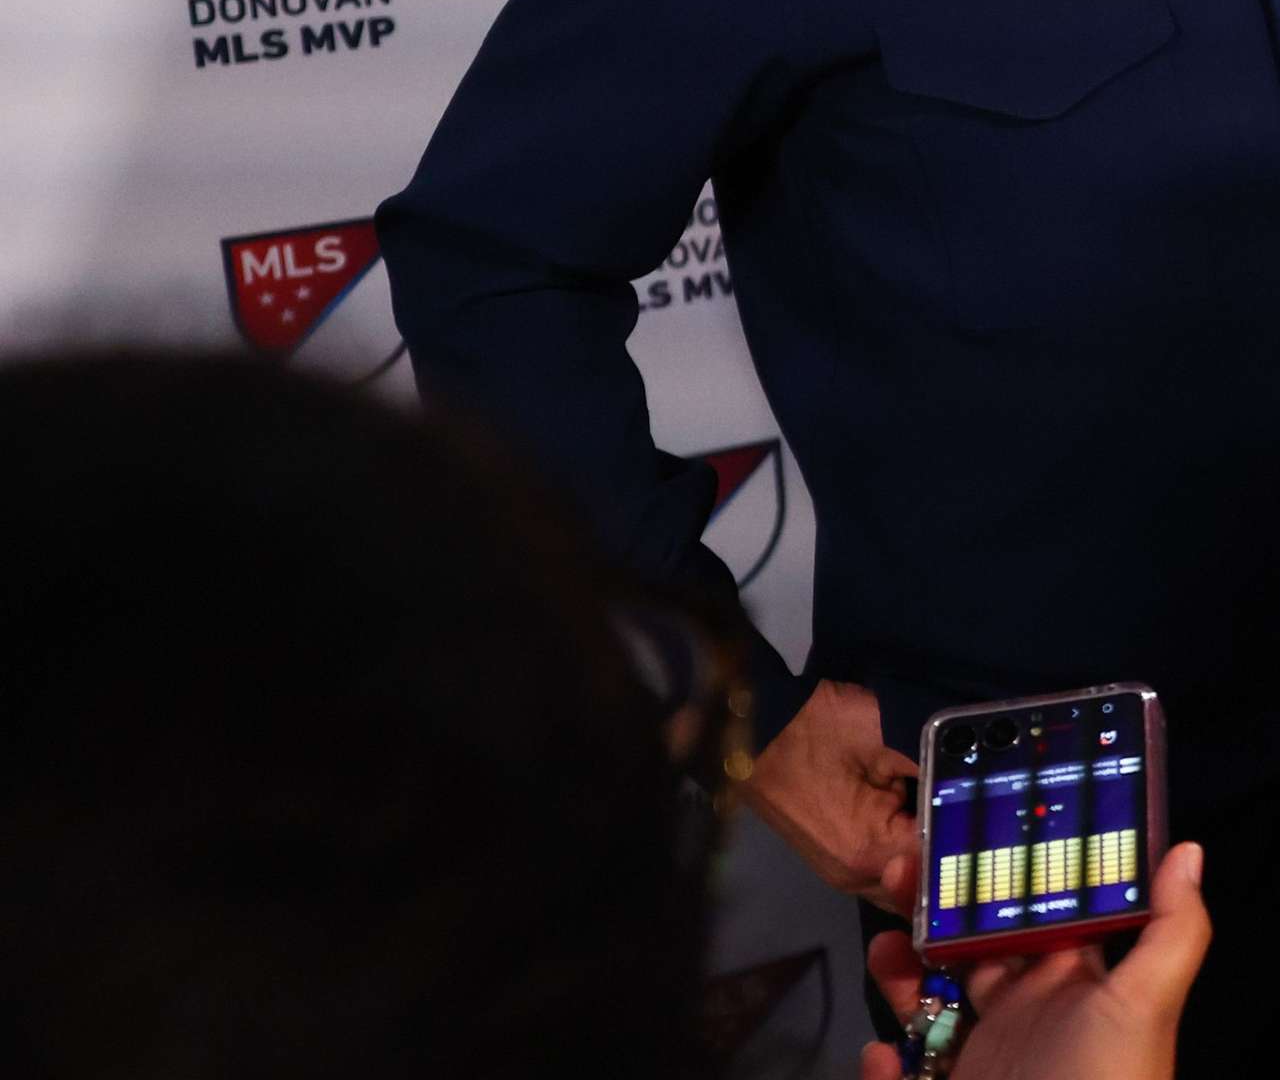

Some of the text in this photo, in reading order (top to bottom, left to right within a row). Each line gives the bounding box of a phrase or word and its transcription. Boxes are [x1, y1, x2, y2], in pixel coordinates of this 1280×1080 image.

[193, 16, 395, 69] MLS MVP
[240, 236, 348, 286] MLS
[683, 271, 733, 303] MV
